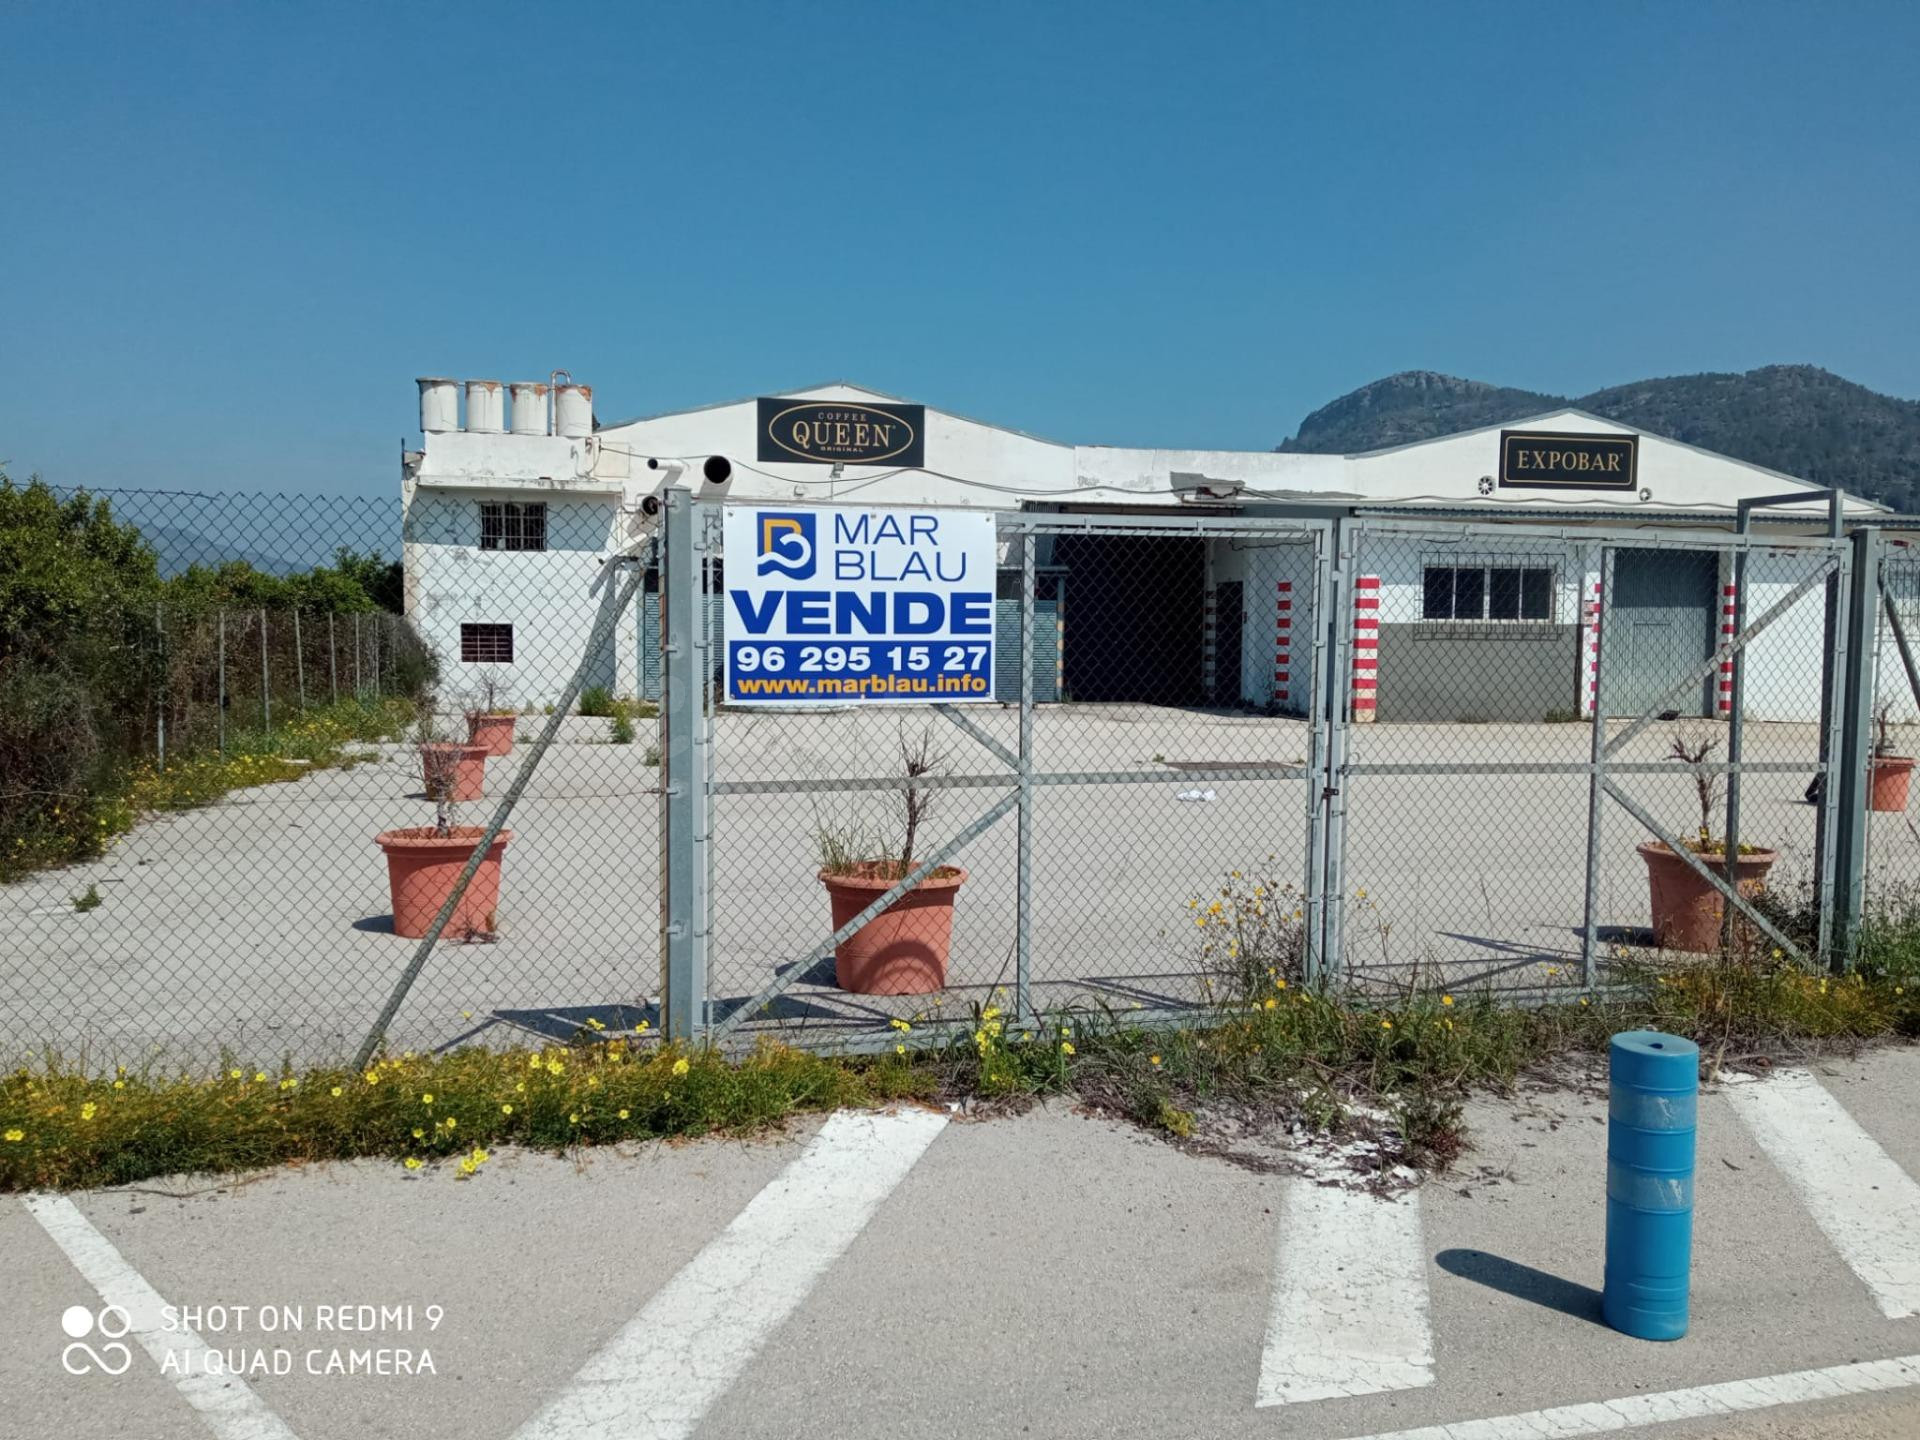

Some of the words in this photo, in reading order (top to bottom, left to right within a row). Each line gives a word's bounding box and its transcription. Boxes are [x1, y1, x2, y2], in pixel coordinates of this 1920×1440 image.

[818, 412, 867, 421] COFFEE
[793, 421, 890, 449] QUEEN
[1517, 450, 1621, 471] EXPOBAR
[834, 513, 939, 546] MAR
[835, 550, 966, 582] BLAU
[730, 590, 992, 634] VENDE
[737, 646, 786, 672] 96
[799, 646, 871, 672] 295
[888, 646, 930, 671] 15
[943, 646, 987, 670] 27
[738, 674, 986, 694] www.marblau.info
